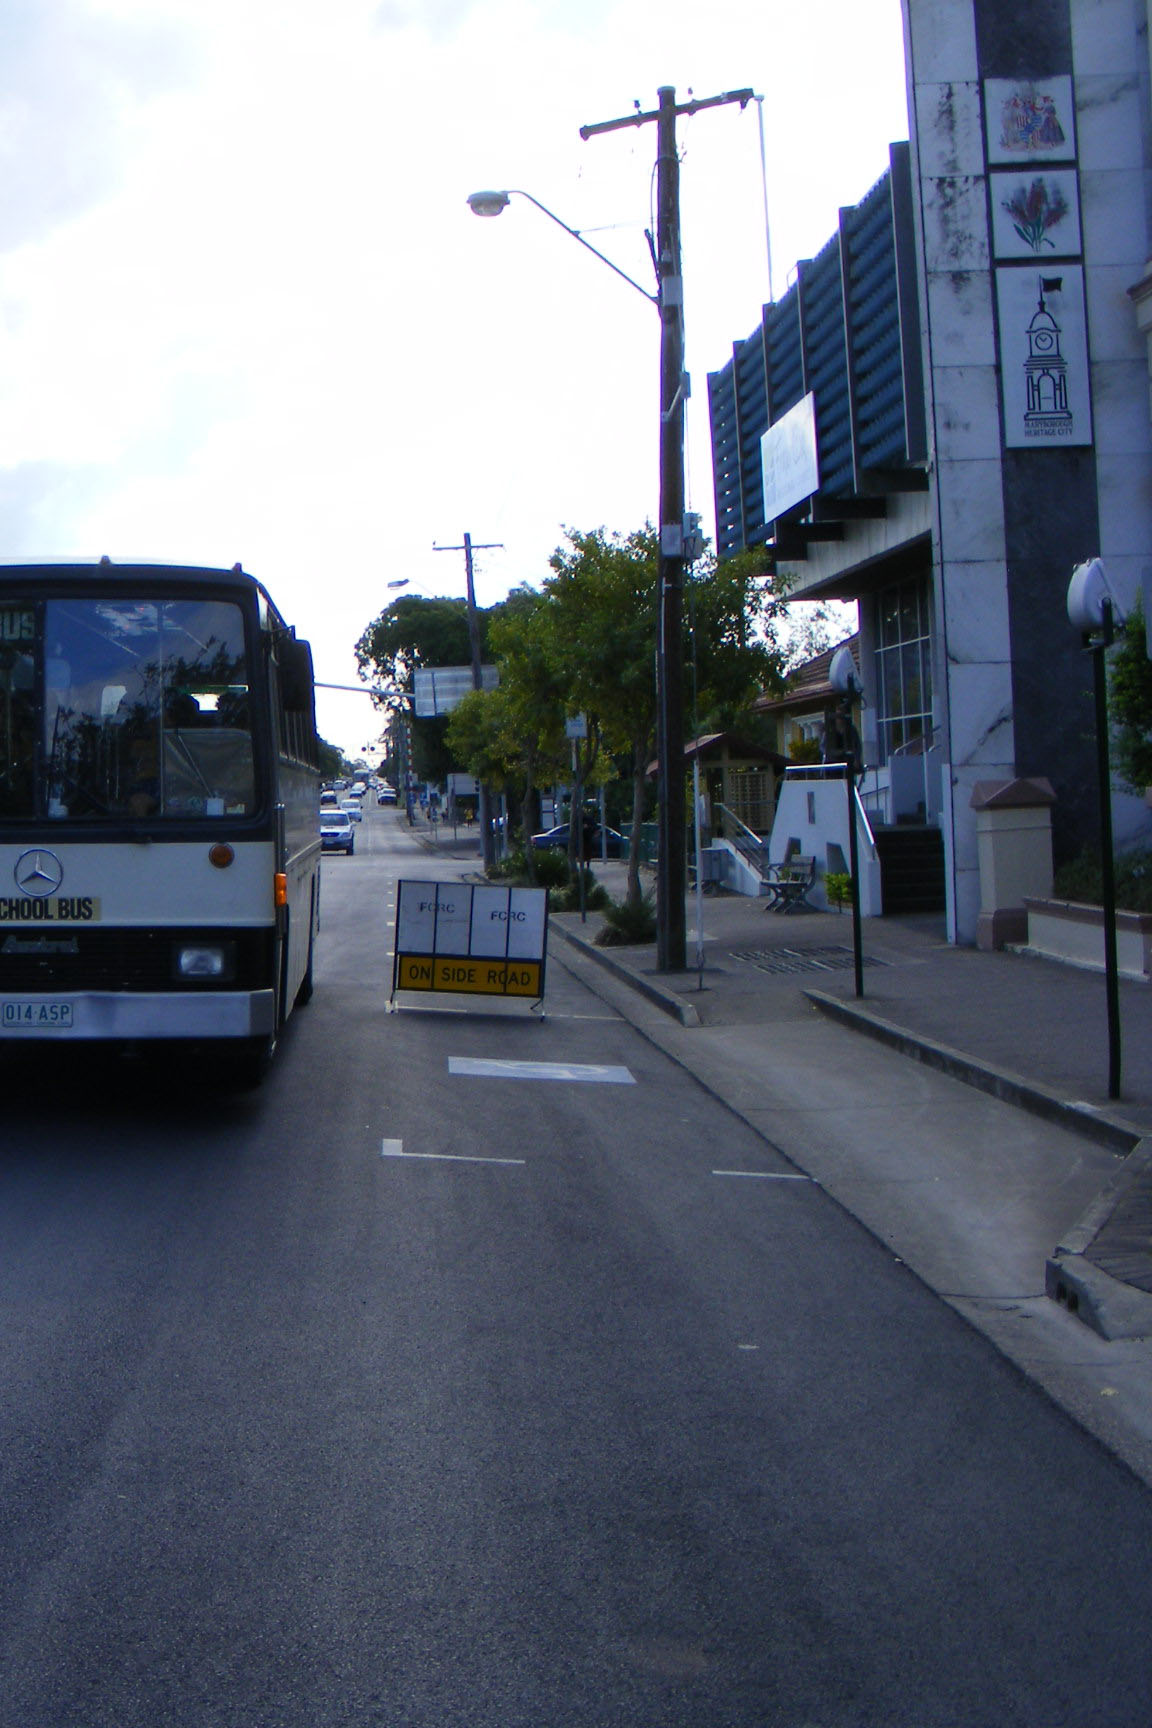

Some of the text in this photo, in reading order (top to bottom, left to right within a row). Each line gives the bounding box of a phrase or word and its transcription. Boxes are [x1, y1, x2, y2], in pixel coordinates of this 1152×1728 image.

[57, 897, 93, 920] BUS
[409, 965, 532, 986] ON SIDE ROAD
